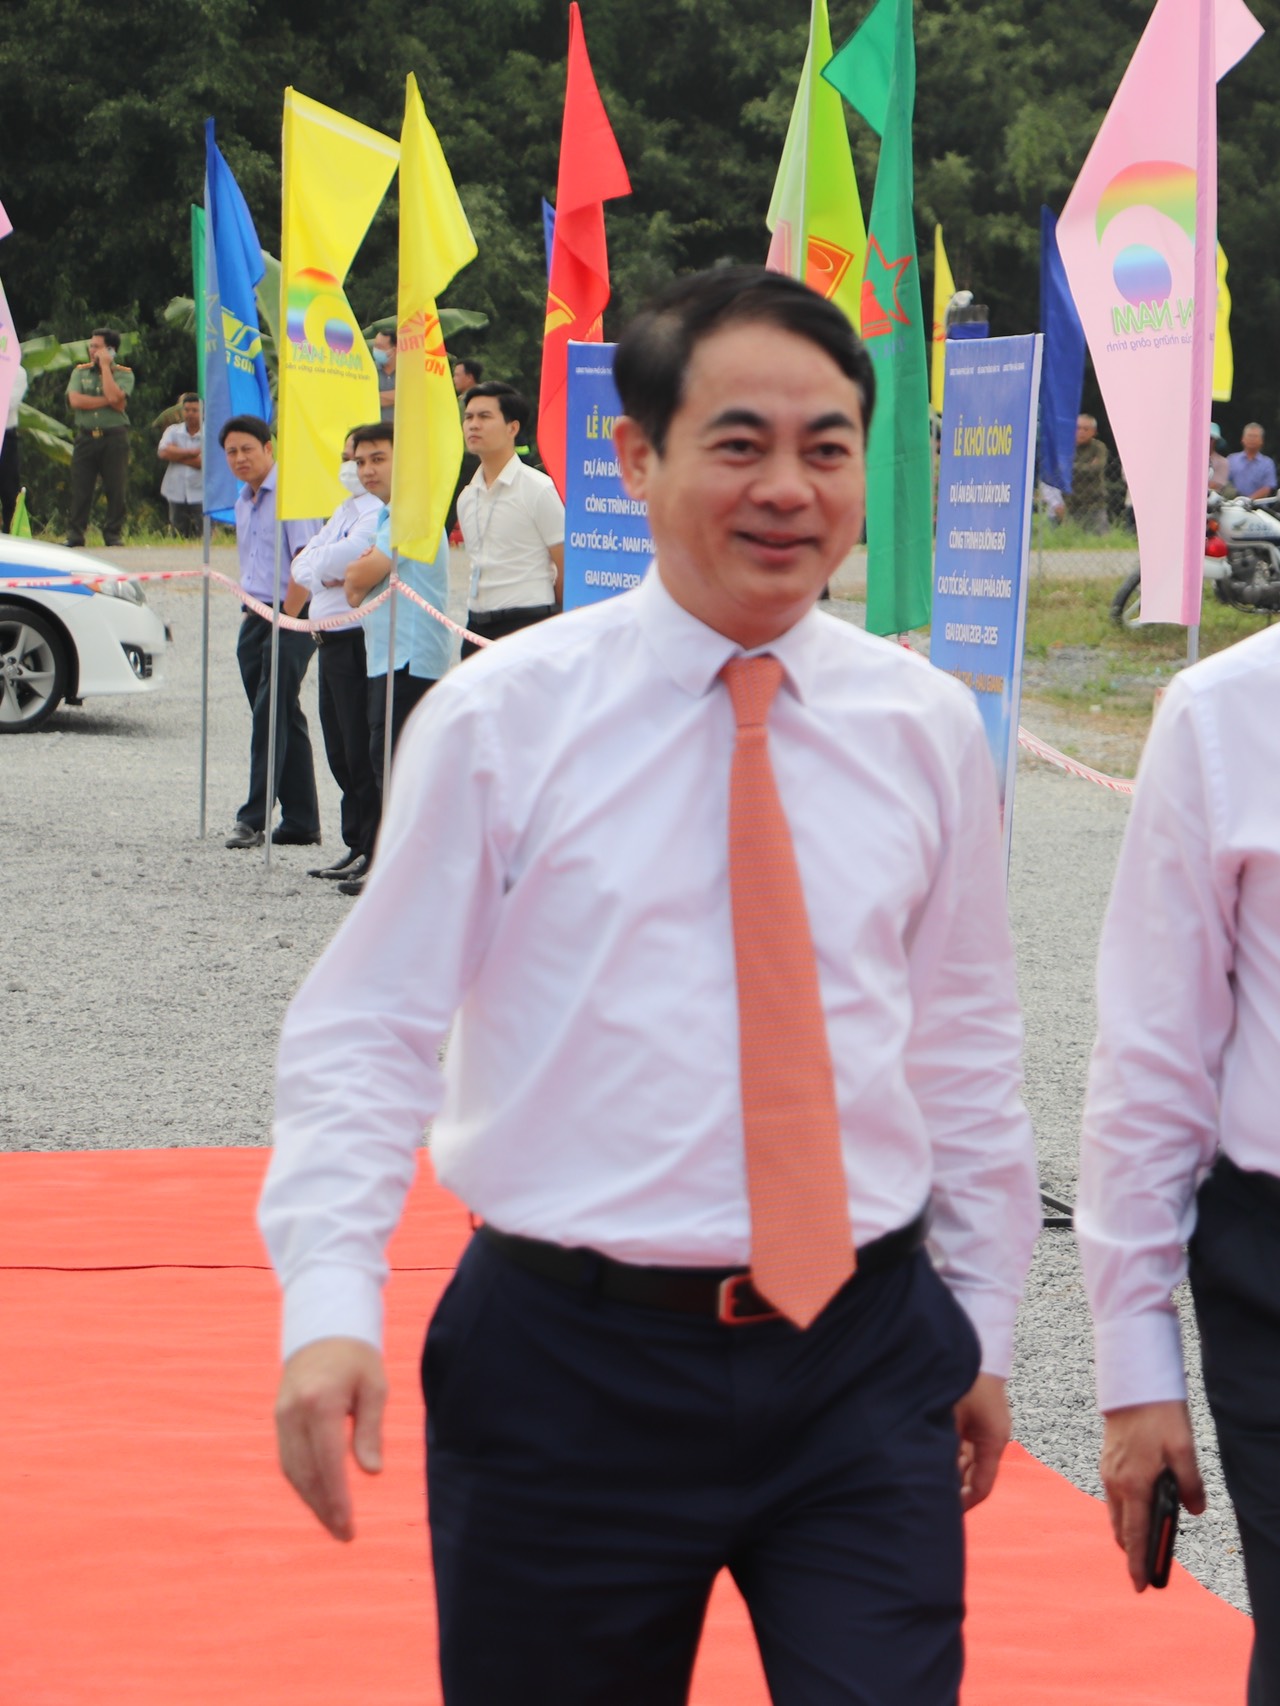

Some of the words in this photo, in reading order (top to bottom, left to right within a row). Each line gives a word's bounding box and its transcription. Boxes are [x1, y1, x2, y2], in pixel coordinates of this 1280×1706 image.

[425, 358, 445, 376] ƠN
[586, 404, 598, 439] LỄ
[986, 418, 1012, 456] CÔNG
[596, 457, 607, 477] ÁN
[585, 493, 607, 513] CÔNG
[607, 494, 630, 515] TRÌNH
[570, 532, 586, 548] CAO
[587, 528, 602, 550] TỐC
[602, 529, 618, 551] BẮC
[622, 536, 641, 552] NAM
[949, 526, 963, 549] CÔNG
[585, 570, 600, 586] GIAI
[601, 572, 622, 590] ĐOẠN
[938, 576, 948, 594] CAO
[948, 569, 958, 595] TỐC
[958, 569, 969, 596] BẮC
[971, 578, 984, 597] NAM
